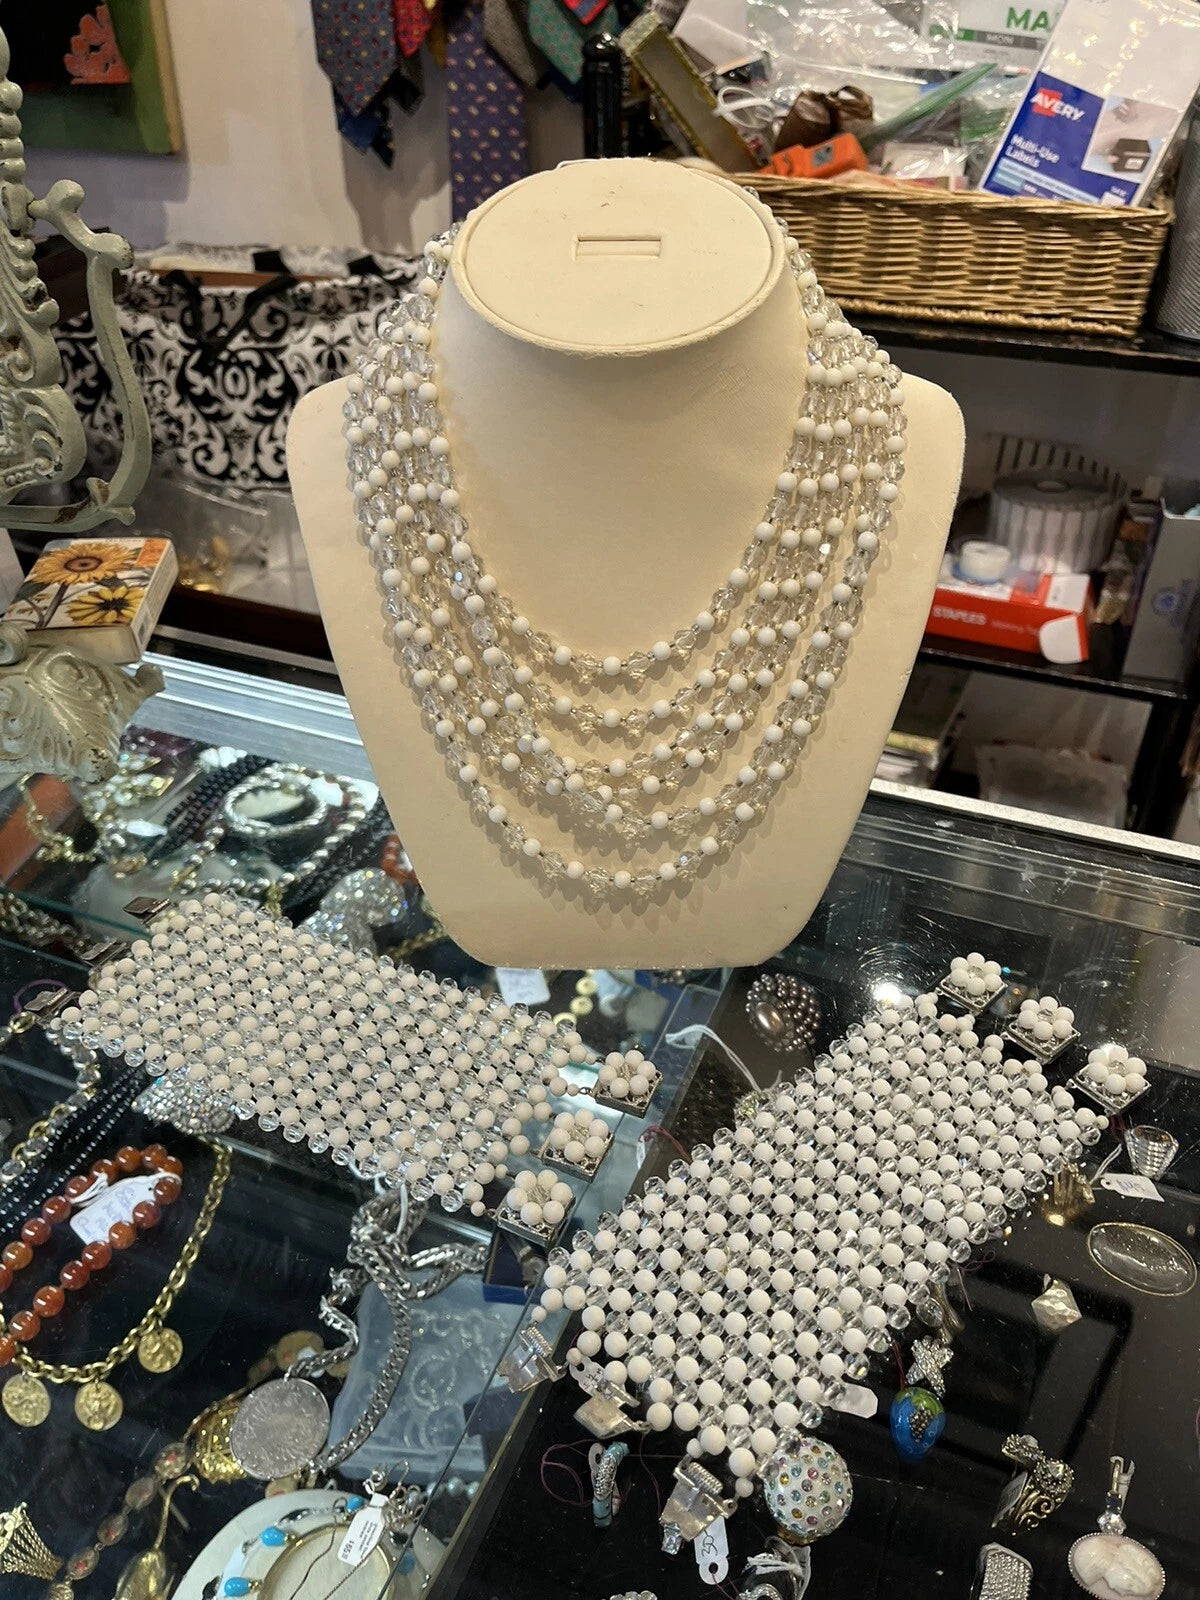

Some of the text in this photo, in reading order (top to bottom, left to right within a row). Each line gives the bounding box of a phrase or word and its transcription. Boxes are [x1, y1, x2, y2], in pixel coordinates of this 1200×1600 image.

[1006, 7, 1057, 33] MA
[1030, 91, 1086, 121] AVERY
[1006, 146, 1040, 169] Labels
[1010, 134, 1060, 163] Multi-Use
[933, 605, 988, 626] STAPLES
